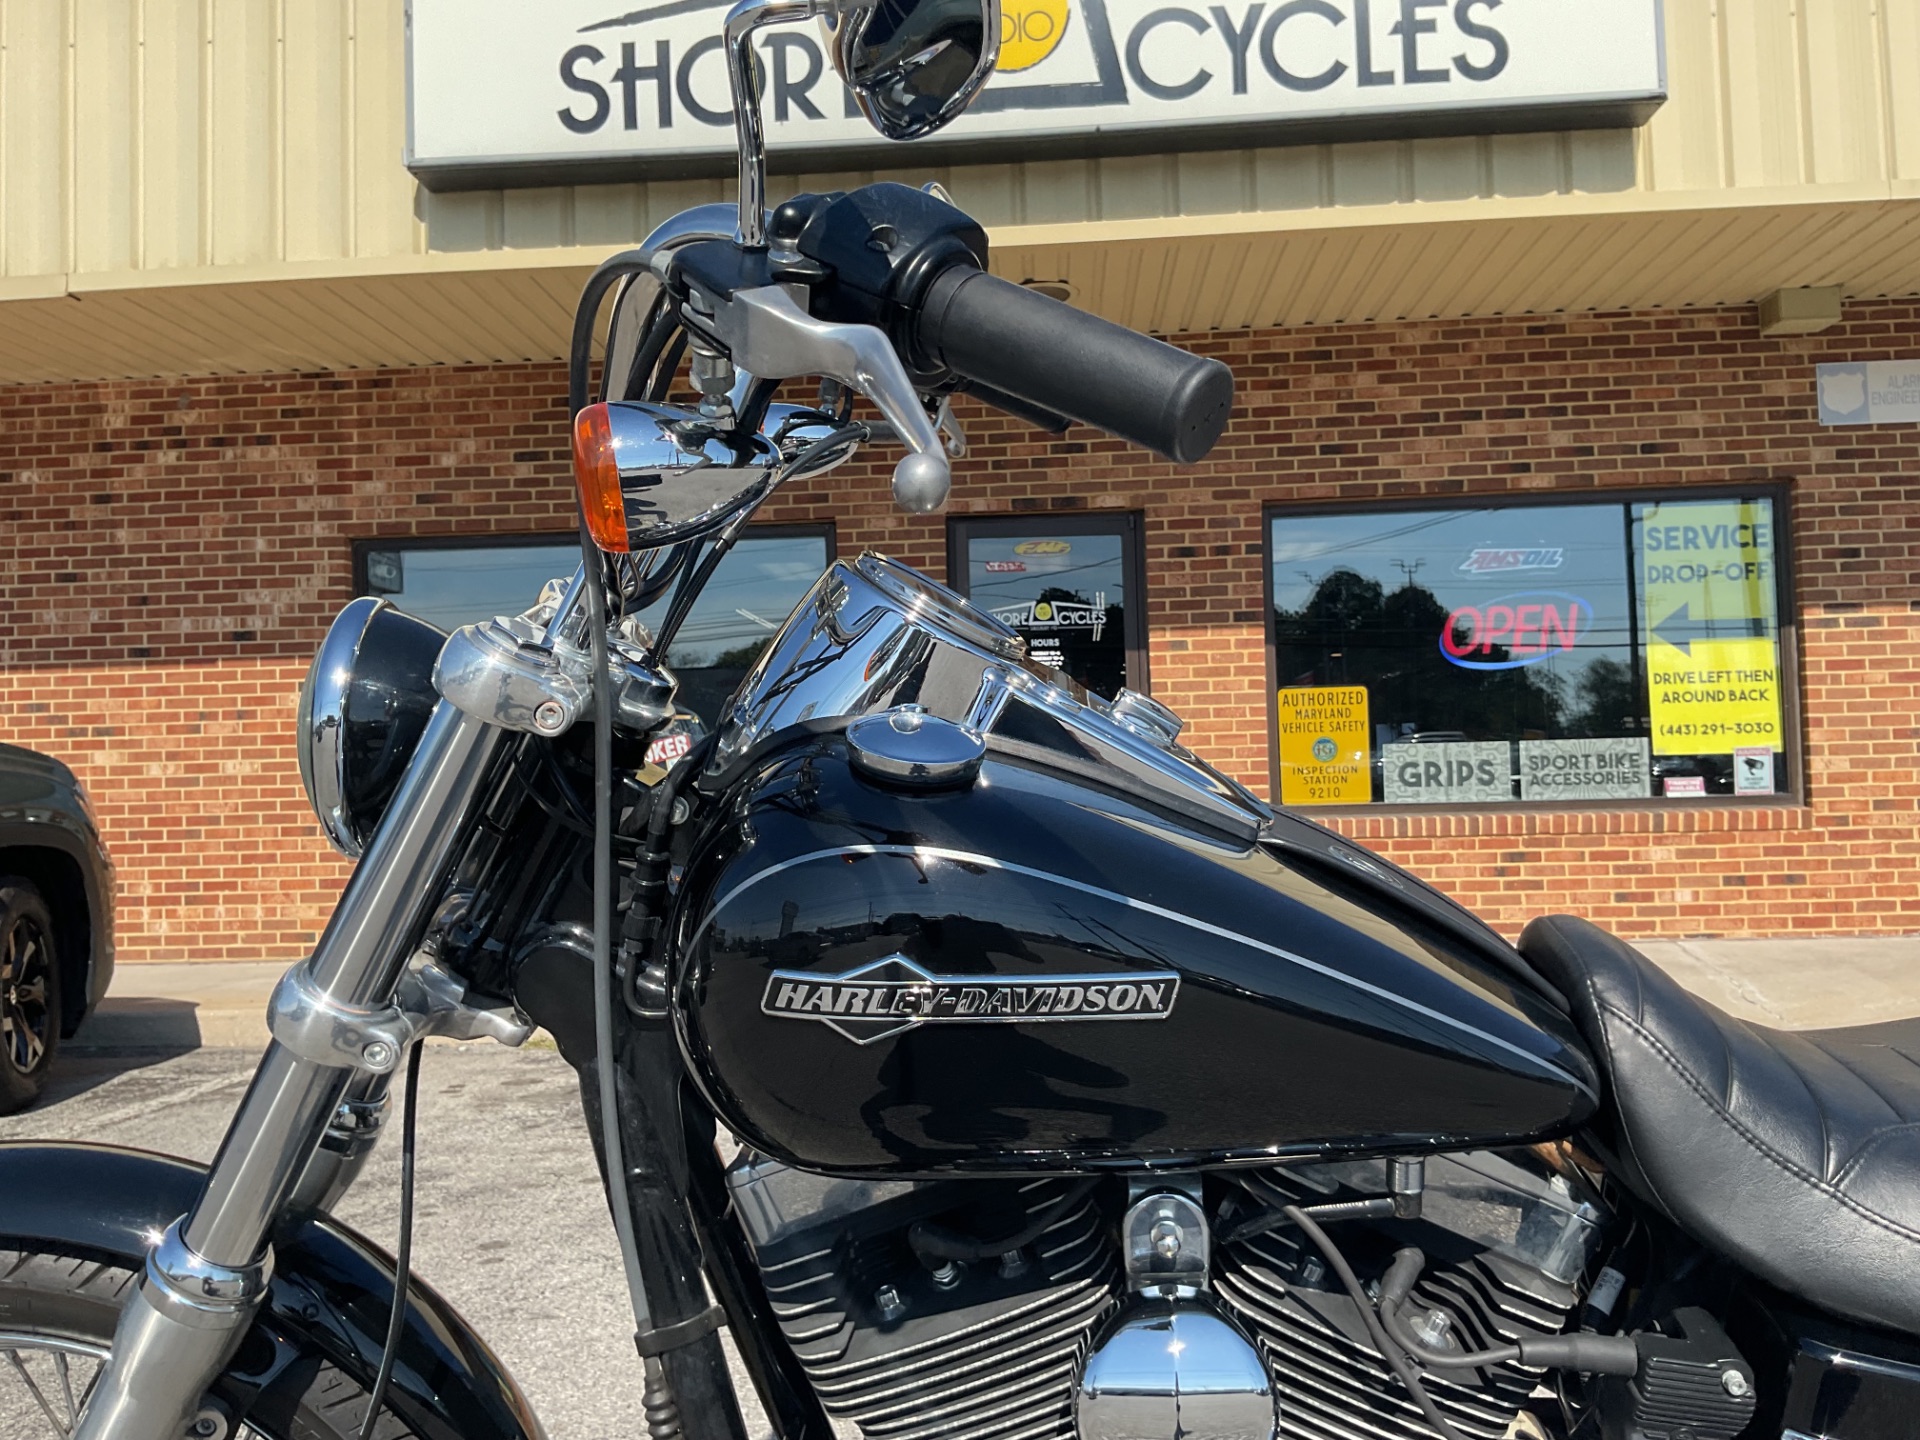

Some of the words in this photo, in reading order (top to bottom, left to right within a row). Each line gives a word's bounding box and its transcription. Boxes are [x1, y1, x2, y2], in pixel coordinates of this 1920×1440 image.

[1125, 0, 1510, 101] CYCLES
[557, 31, 868, 135] SHOR
[1871, 390, 1920, 406] ENGINEE
[1646, 523, 1770, 552] SERVICE
[1458, 548, 1564, 573] AMSOIL
[1647, 562, 1769, 584] DROP-OFF
[1058, 611, 1107, 625] CYCLES
[1442, 603, 1579, 657] OPEN
[1030, 638, 1060, 647] HOURS
[1653, 671, 1696, 685] DRIVE
[1698, 670, 1732, 684] LEFT
[1735, 669, 1774, 682] THEN
[1282, 691, 1364, 707] AUTHORIZED
[1661, 690, 1726, 704] AROUND
[1728, 688, 1770, 702] BACK
[1295, 708, 1352, 720] MARYLAND
[1282, 721, 1325, 733] VEHICLE
[1329, 720, 1366, 732] SAFETY
[1660, 723, 1698, 736] (443)
[1701, 722, 1775, 735] 291-3030
[1292, 765, 1359, 775] INSPECTION
[1529, 754, 1592, 772] SPORT
[1596, 752, 1641, 770] BIKE
[1303, 775, 1348, 785] STATION
[1399, 759, 1496, 788] GRIPS
[1529, 770, 1642, 787] ACCESSORIES
[1309, 787, 1341, 798] 9210
[774, 983, 1166, 1015] HARLEY-DAVIDSON
